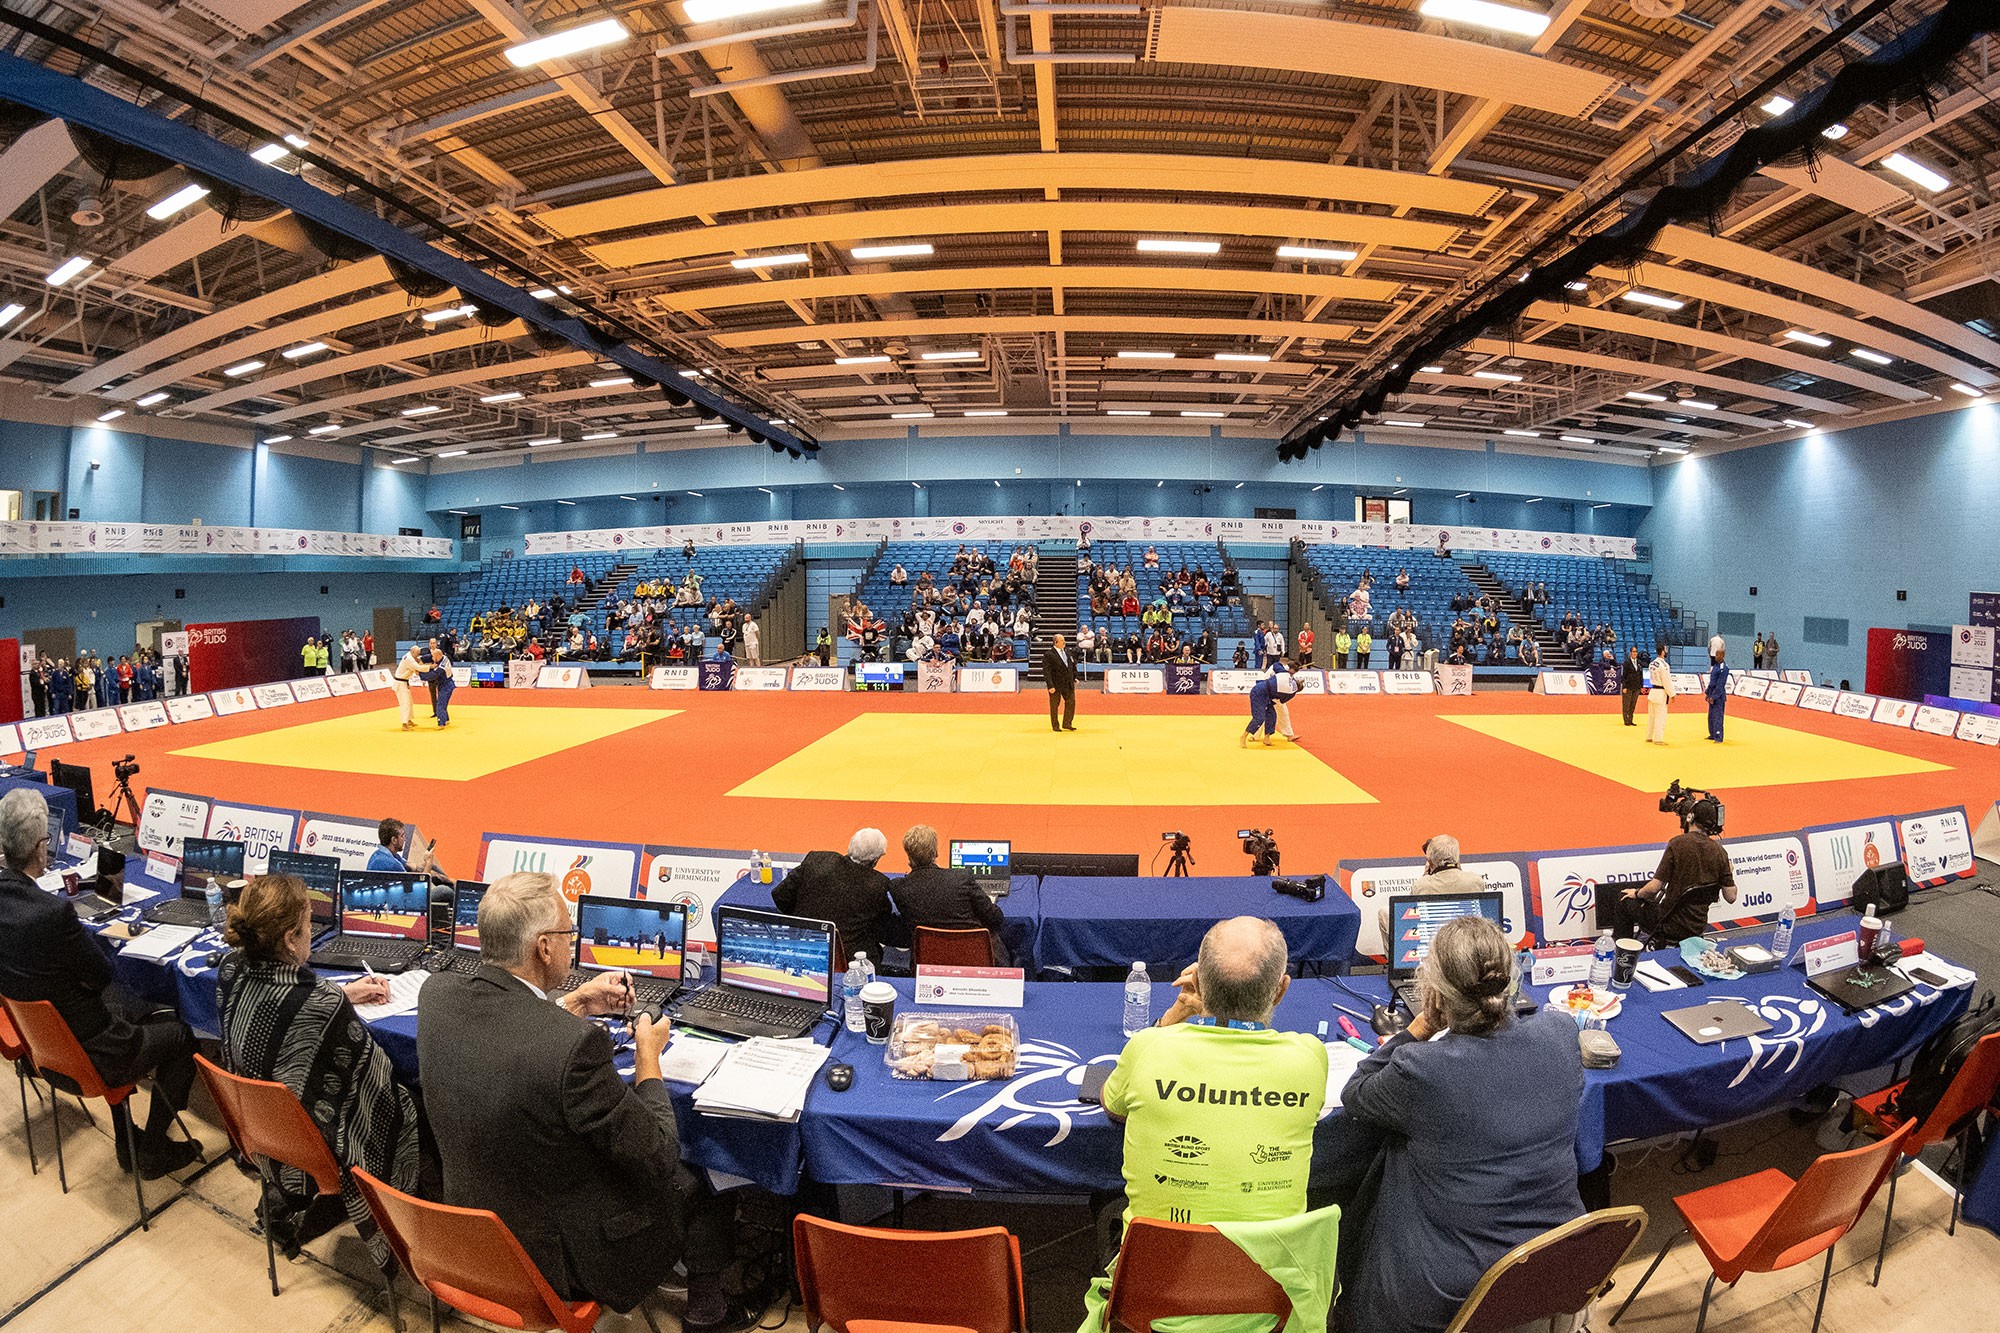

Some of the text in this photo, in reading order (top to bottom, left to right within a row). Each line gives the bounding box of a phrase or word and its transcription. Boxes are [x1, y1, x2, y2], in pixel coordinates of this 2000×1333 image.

[105, 527, 126, 536] RNIB
[143, 528, 164, 537] RNIB
[180, 529, 199, 538] RNIB
[203, 628, 227, 636] BRITISH
[203, 634, 227, 645] JUDO
[1907, 634, 1927, 643] BRITISH
[1907, 641, 1927, 651] JUDO
[45, 729, 66, 740] JUDO
[180, 803, 199, 814] RNIB
[1940, 816, 1958, 828] RNIB
[244, 826, 284, 844] BRITISH
[345, 837, 361, 846] World
[332, 846, 364, 857] Birmingham
[987, 854, 992, 862] 1
[1746, 855, 1763, 864] World
[1764, 852, 1783, 861] Games
[675, 867, 714, 876] UNIVERSITY
[1736, 865, 1772, 876] Birmingham
[674, 874, 720, 883] BIRMINGHAM
[1606, 871, 1655, 884] BRITIS
[1379, 886, 1413, 894] BIRMING
[1484, 880, 1514, 890] ingham
[1791, 883, 1804, 891] 2023
[1742, 891, 1772, 907] Judo
[1155, 1079, 1310, 1108] Volunteer
[1171, 1178, 1209, 1186] Birmingham
